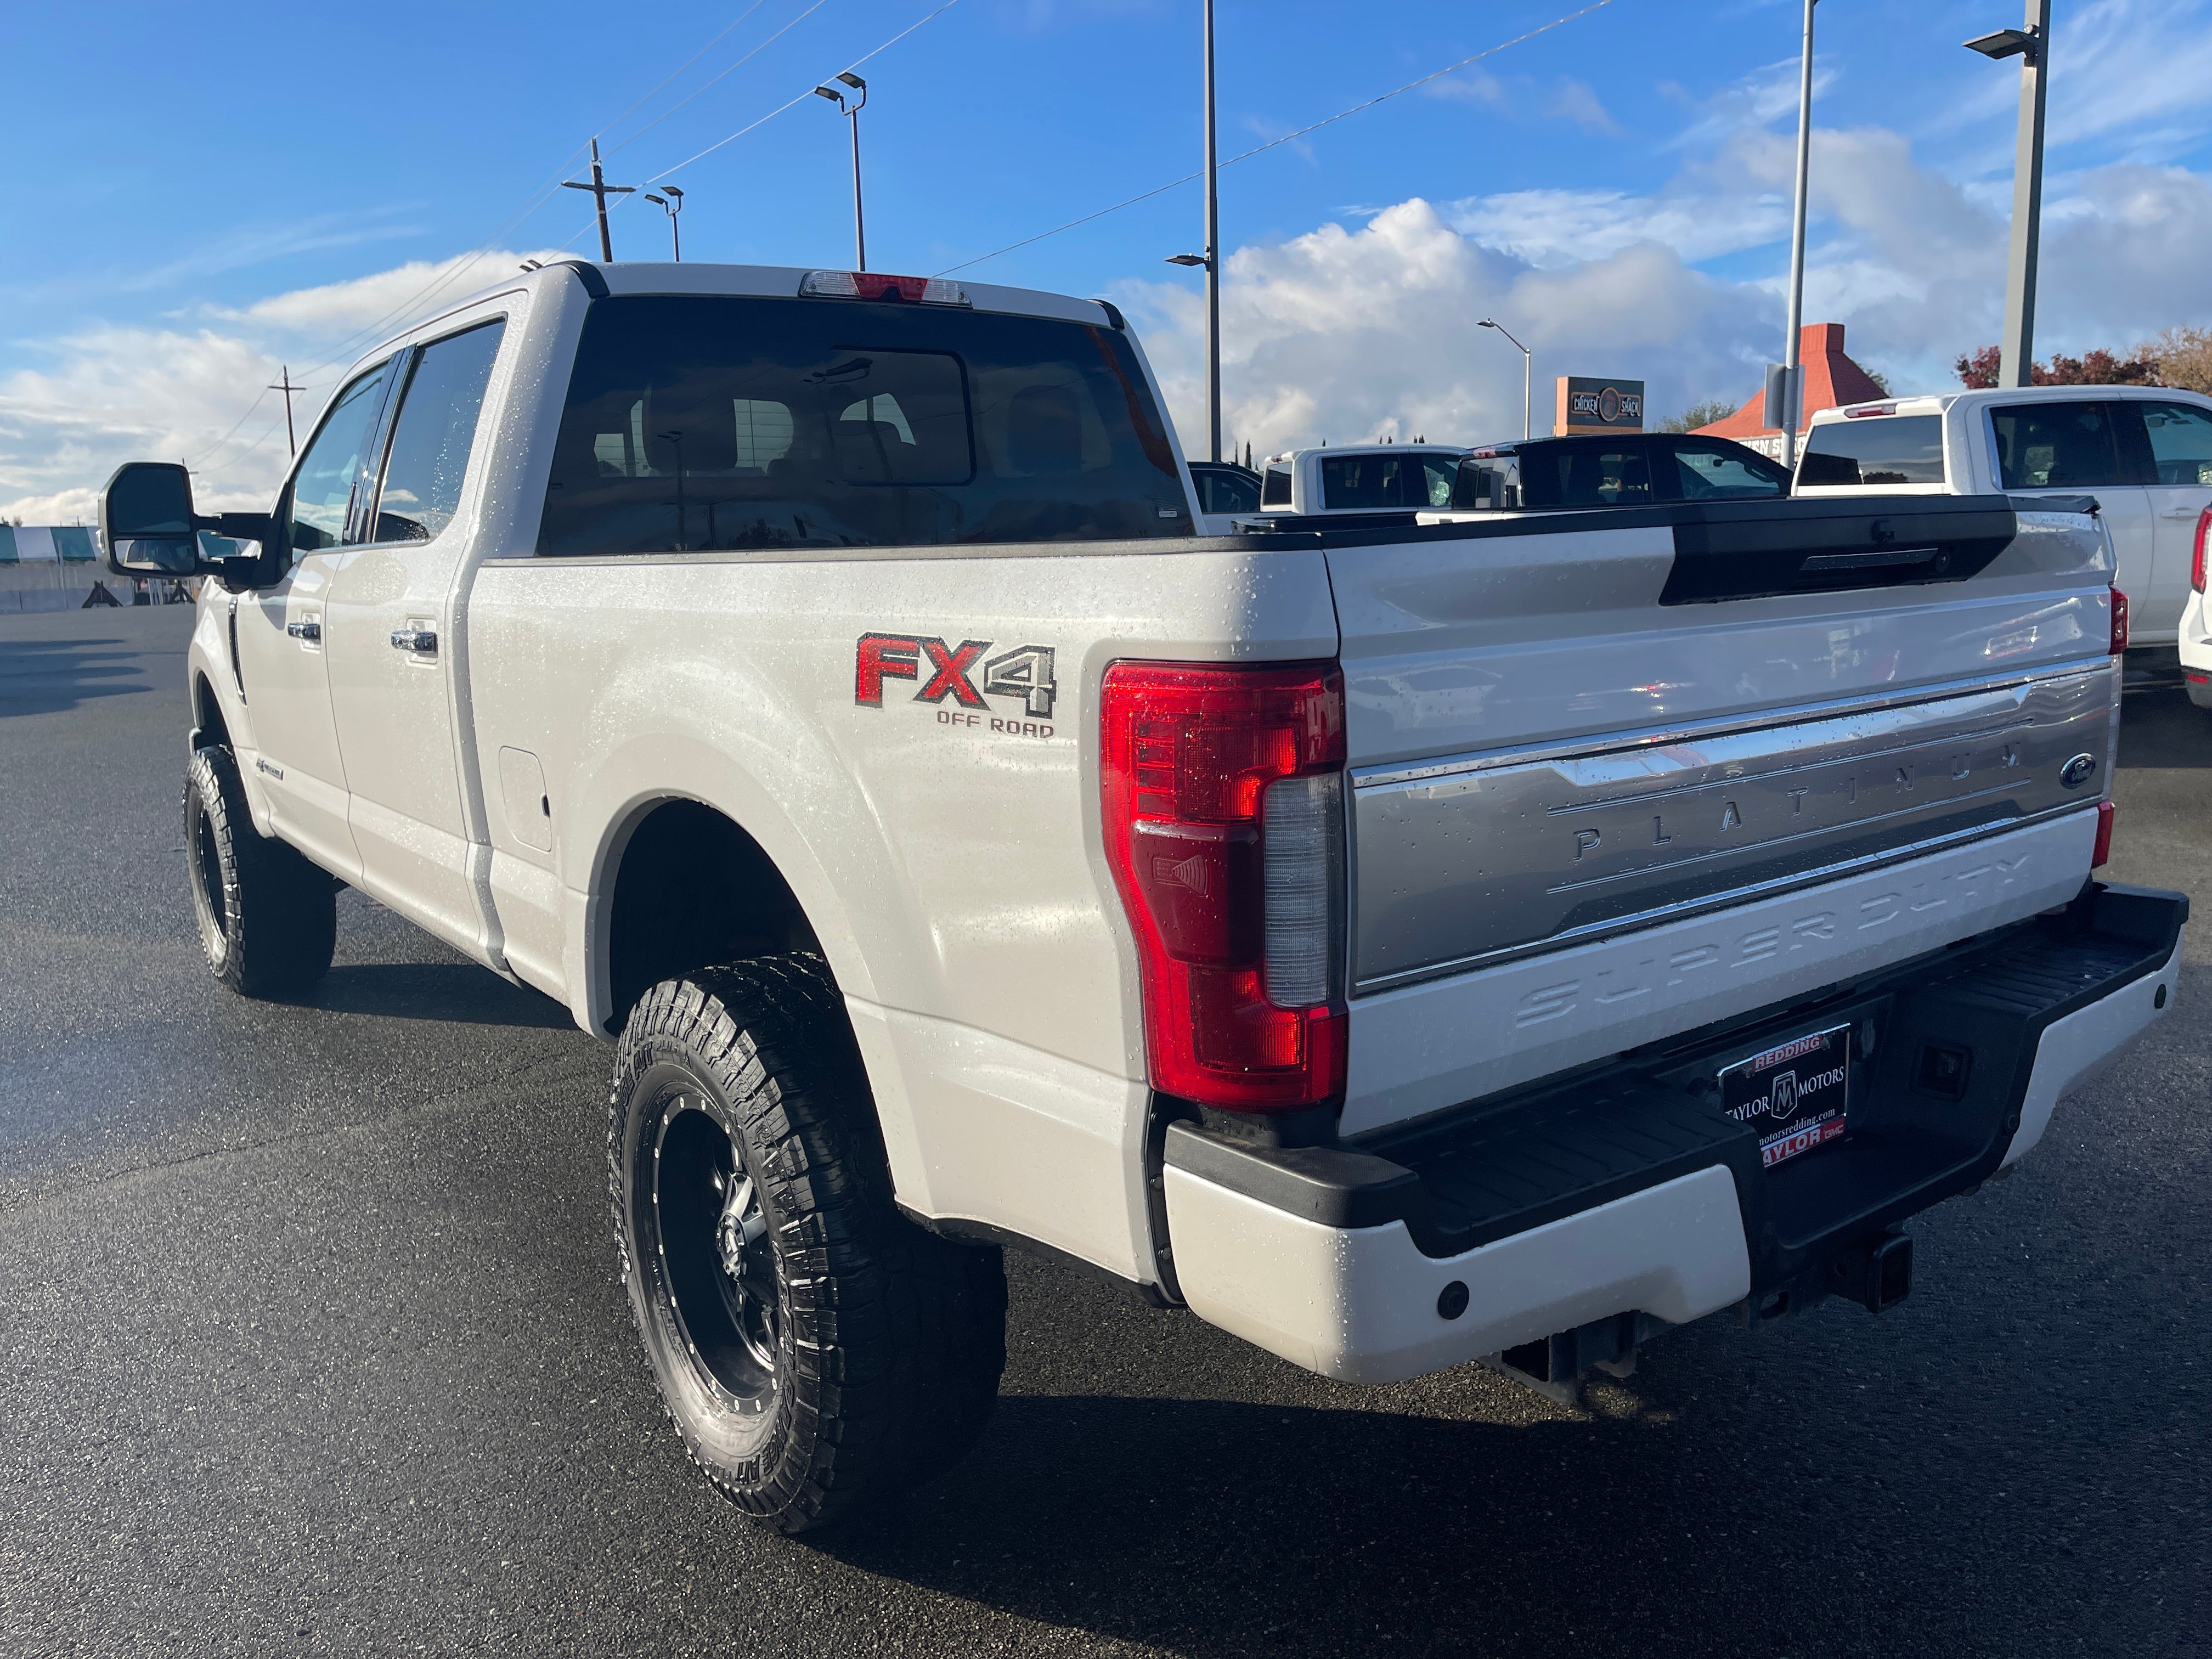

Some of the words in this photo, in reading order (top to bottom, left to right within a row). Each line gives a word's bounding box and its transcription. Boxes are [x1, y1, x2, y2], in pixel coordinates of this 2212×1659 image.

[1574, 395, 1600, 415] CHICKEN
[1621, 397, 1641, 417] SHACK
[855, 632, 1057, 719] FX4
[938, 711, 980, 727] OFF
[990, 718, 1054, 738] ROAD
[1572, 741, 2021, 861] PLATINUM
[1516, 910, 1836, 1027] SUPER
[1858, 853, 2030, 929] DUTY
[1755, 1036, 1820, 1069] REDDING
[1798, 1066, 1844, 1097] MOTORS
[1763, 1129, 1821, 1164] AYLOR
[1825, 1125, 1844, 1139] GMC
